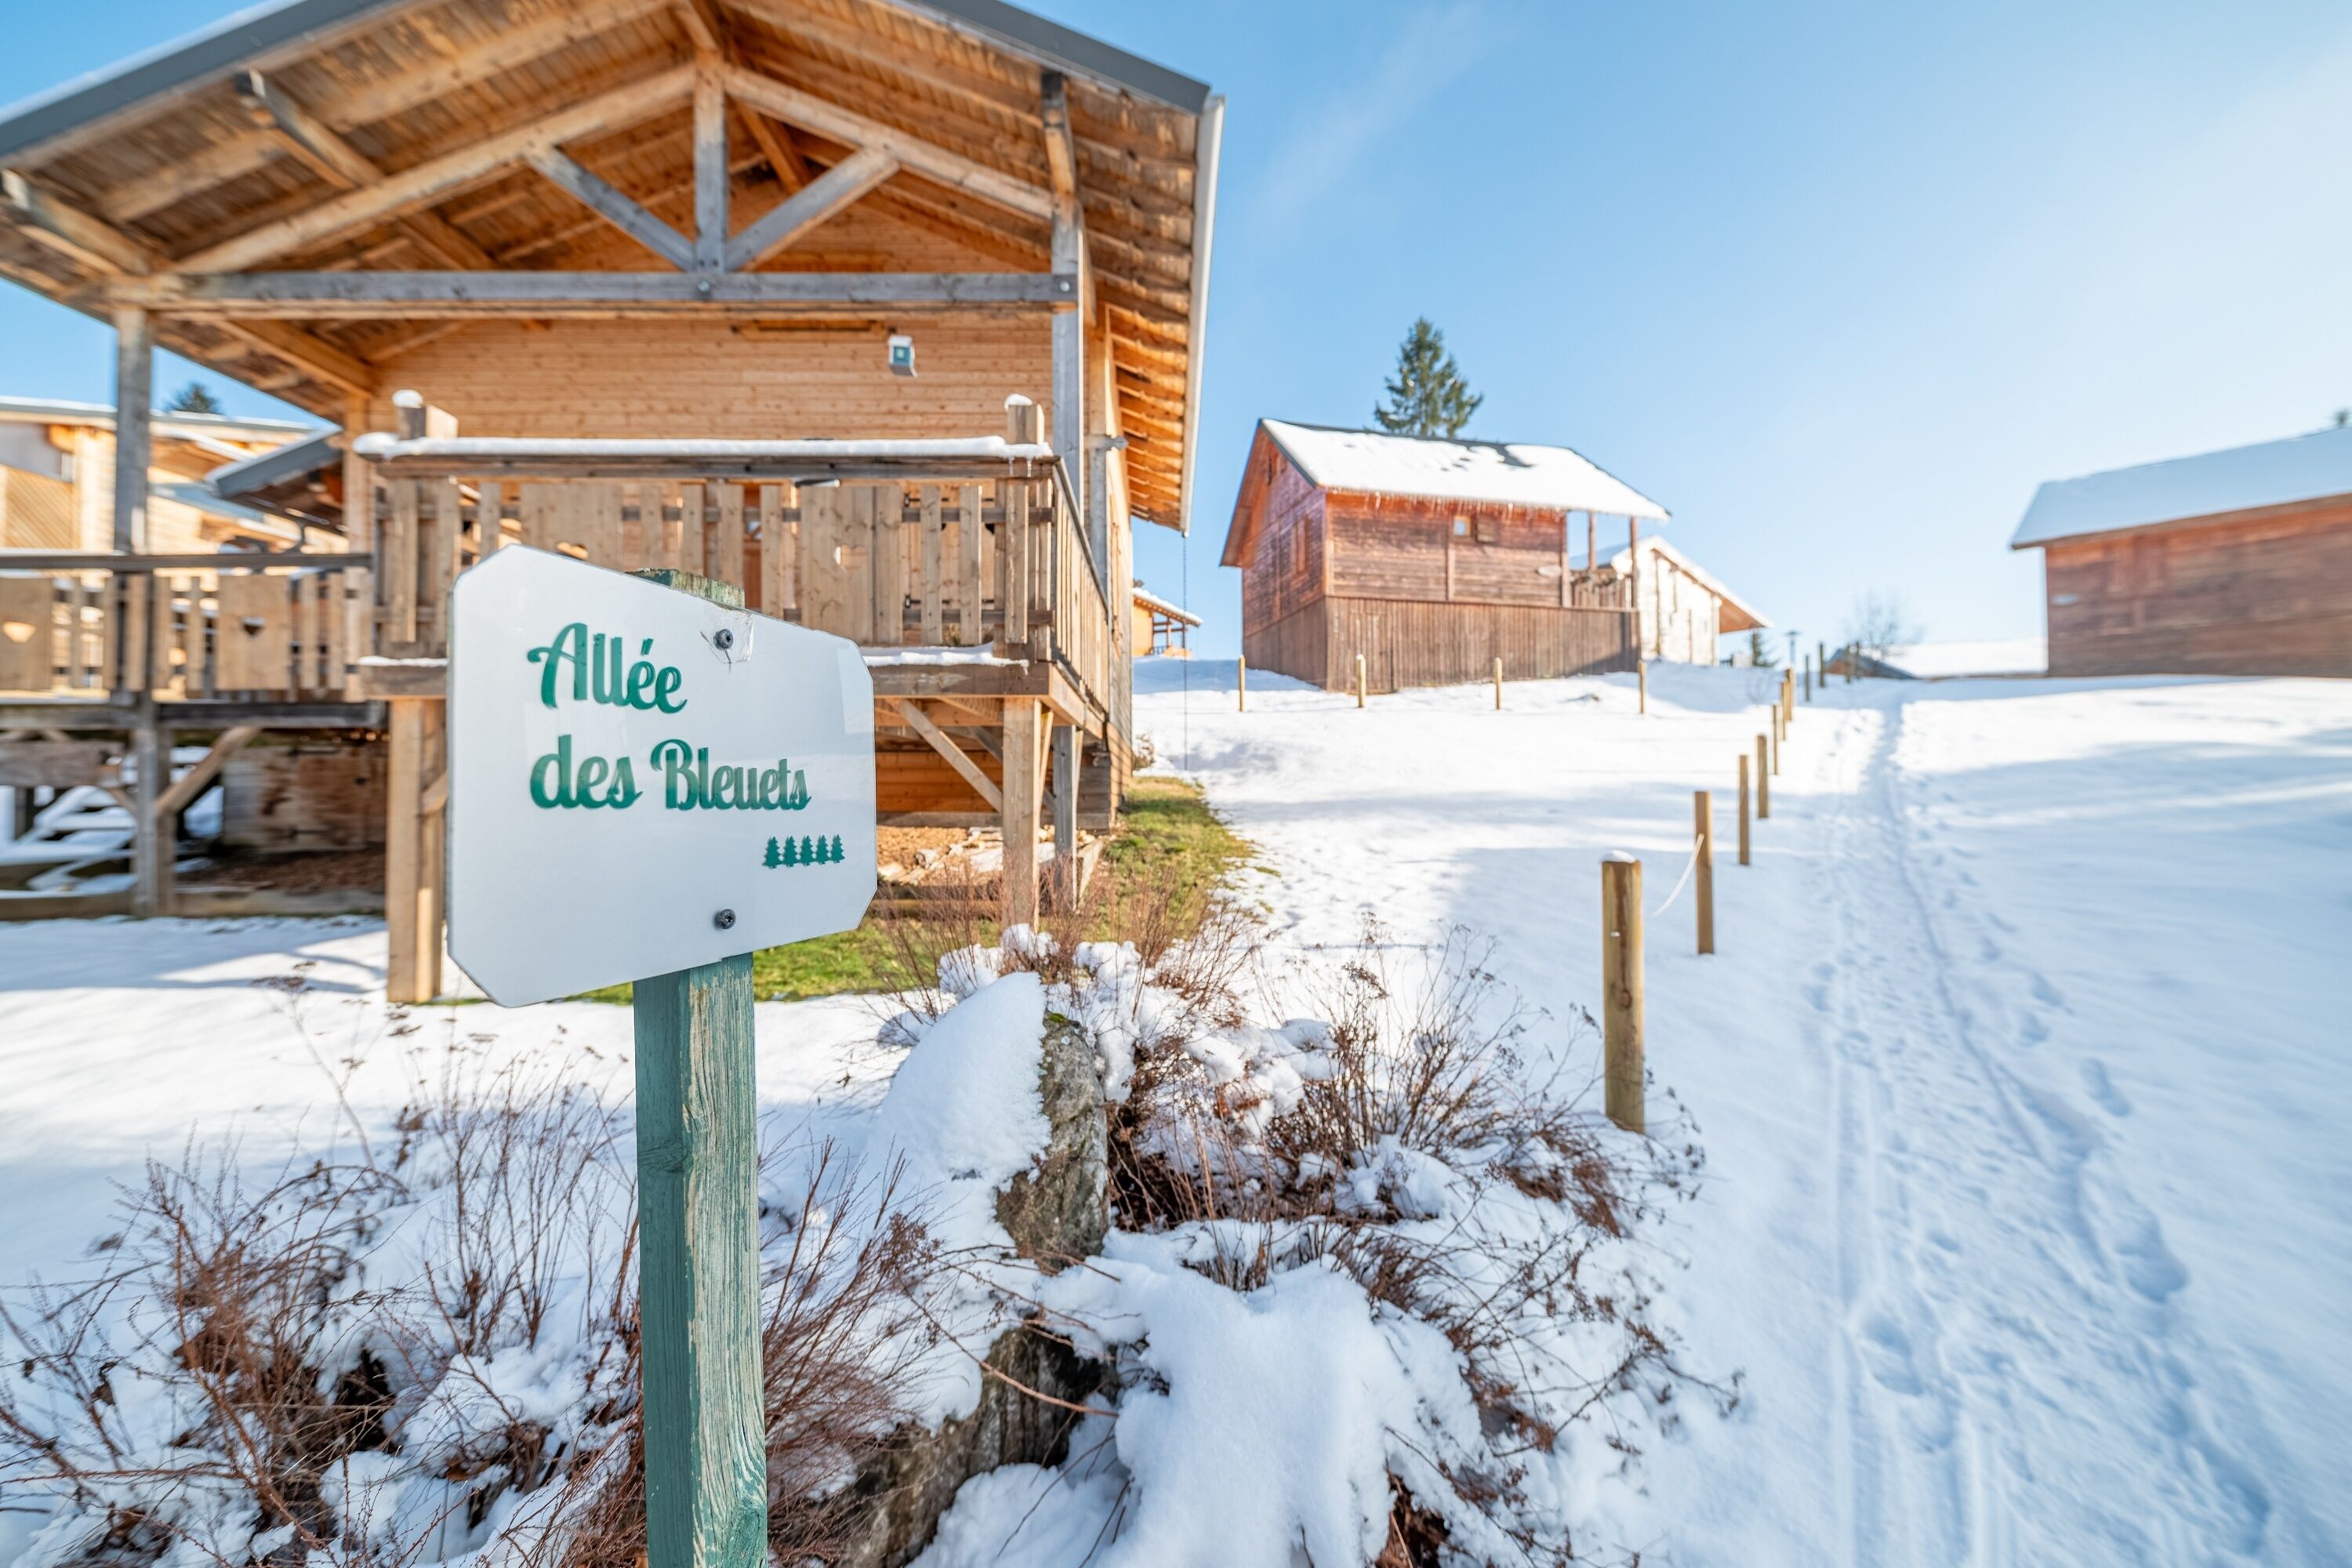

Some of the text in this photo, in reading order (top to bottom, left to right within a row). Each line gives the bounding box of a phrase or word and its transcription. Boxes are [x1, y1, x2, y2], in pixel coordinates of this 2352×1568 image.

[527, 622, 688, 714] Allée
[530, 734, 812, 811] des Bleuets
